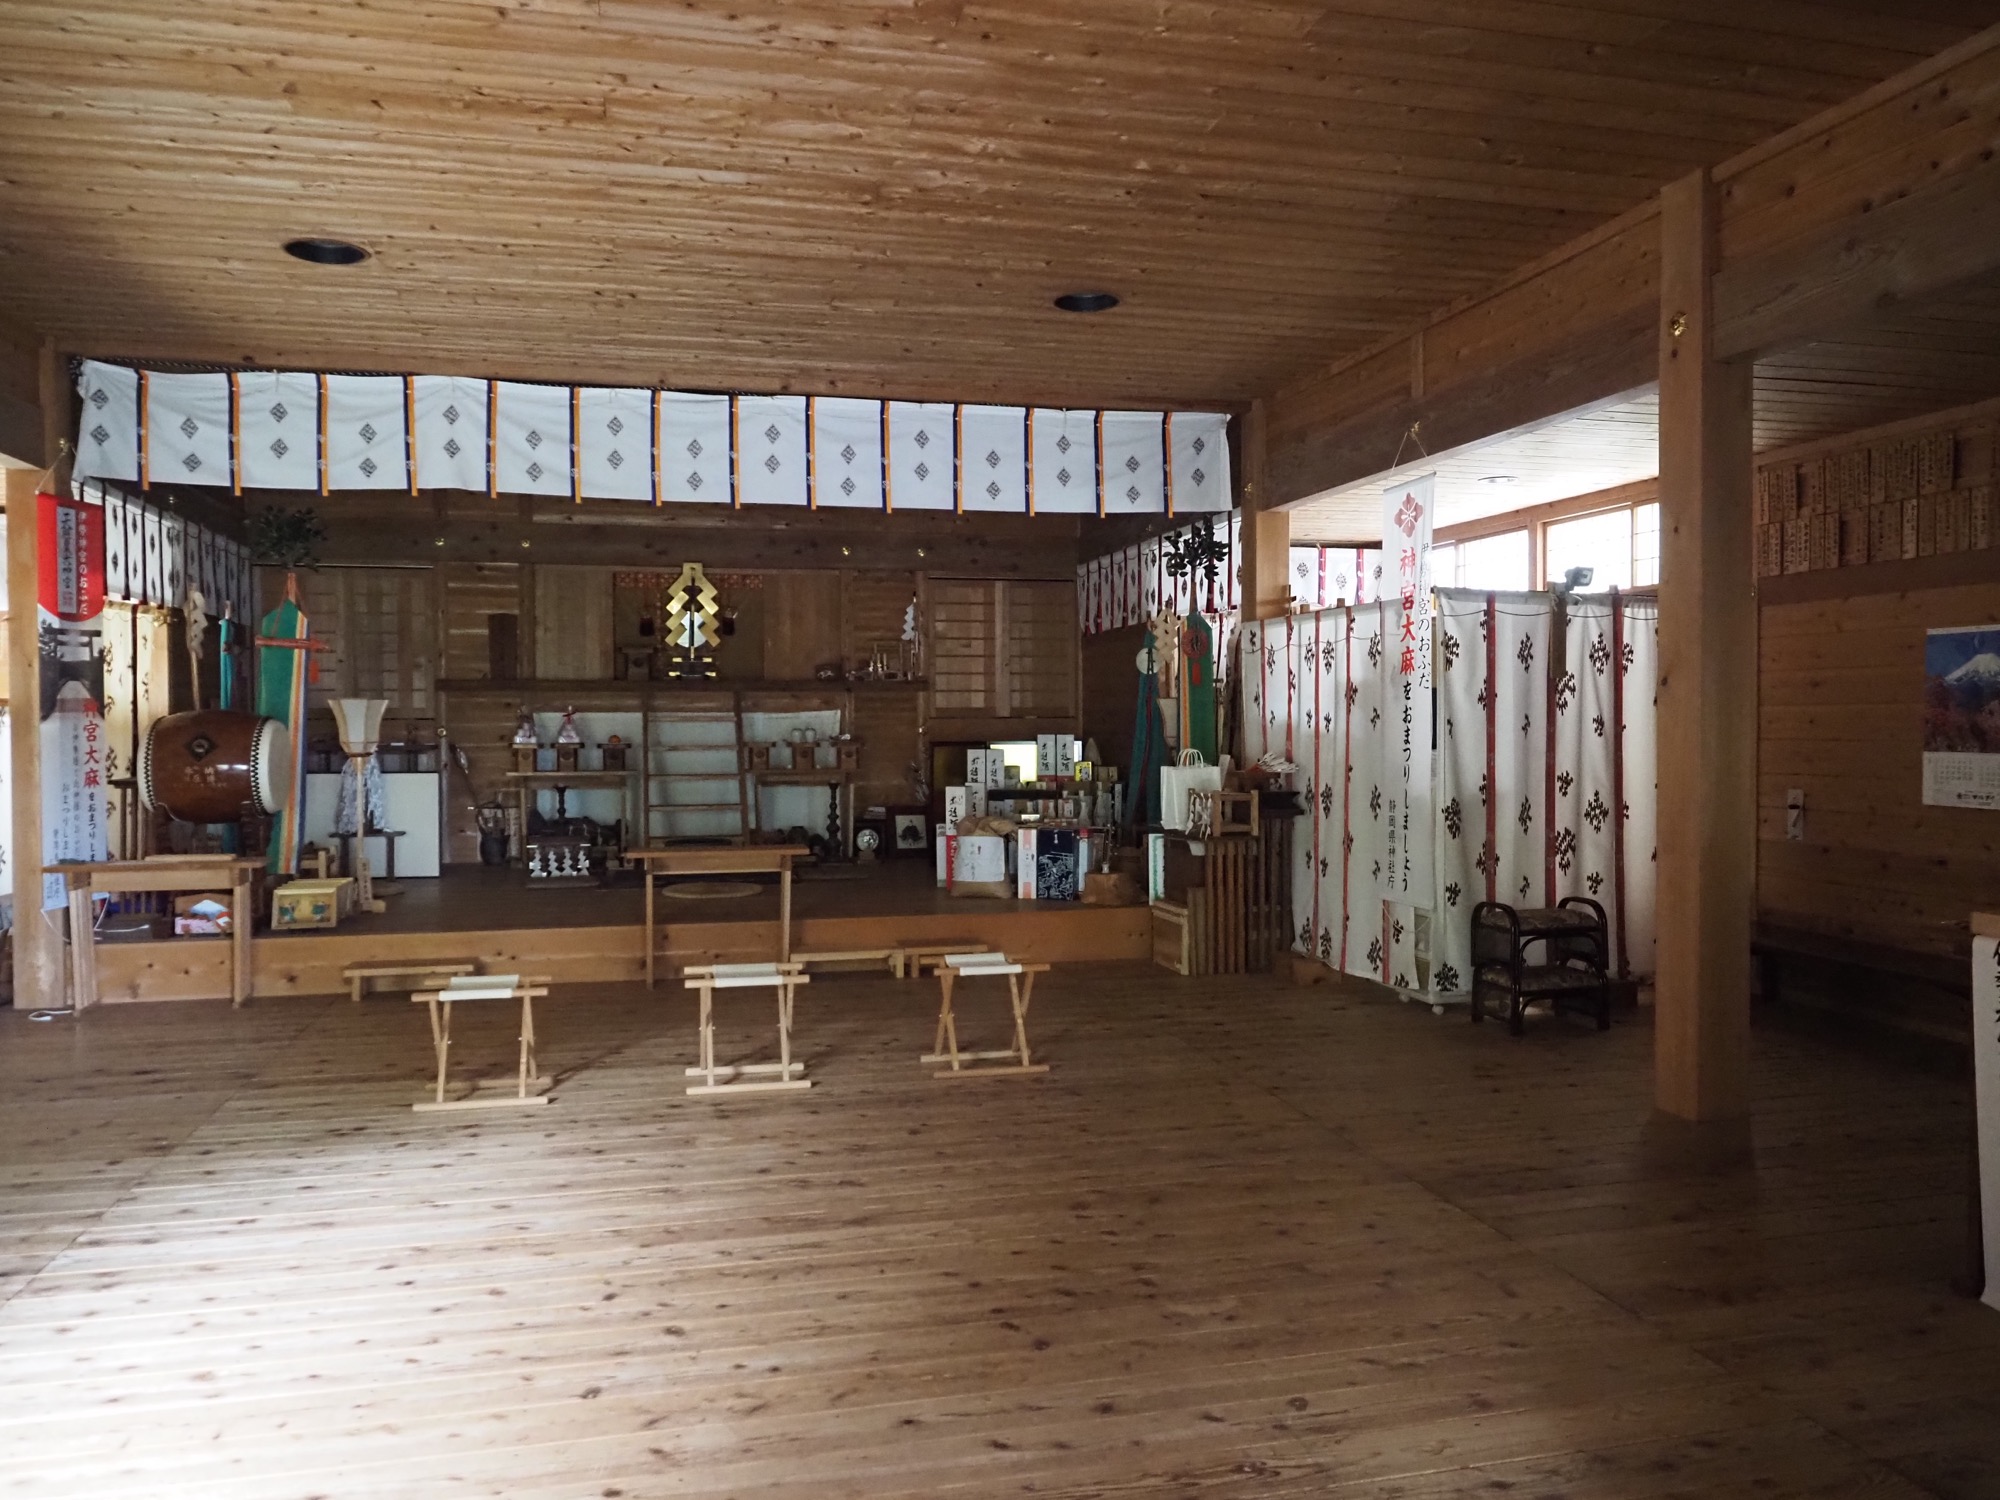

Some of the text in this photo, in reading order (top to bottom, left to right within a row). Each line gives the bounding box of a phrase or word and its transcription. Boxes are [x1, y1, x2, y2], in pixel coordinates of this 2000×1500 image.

[1418, 542, 1431, 689] 伊勢神宮のおふだ
[1388, 799, 1397, 889] 静岡県神社庁
